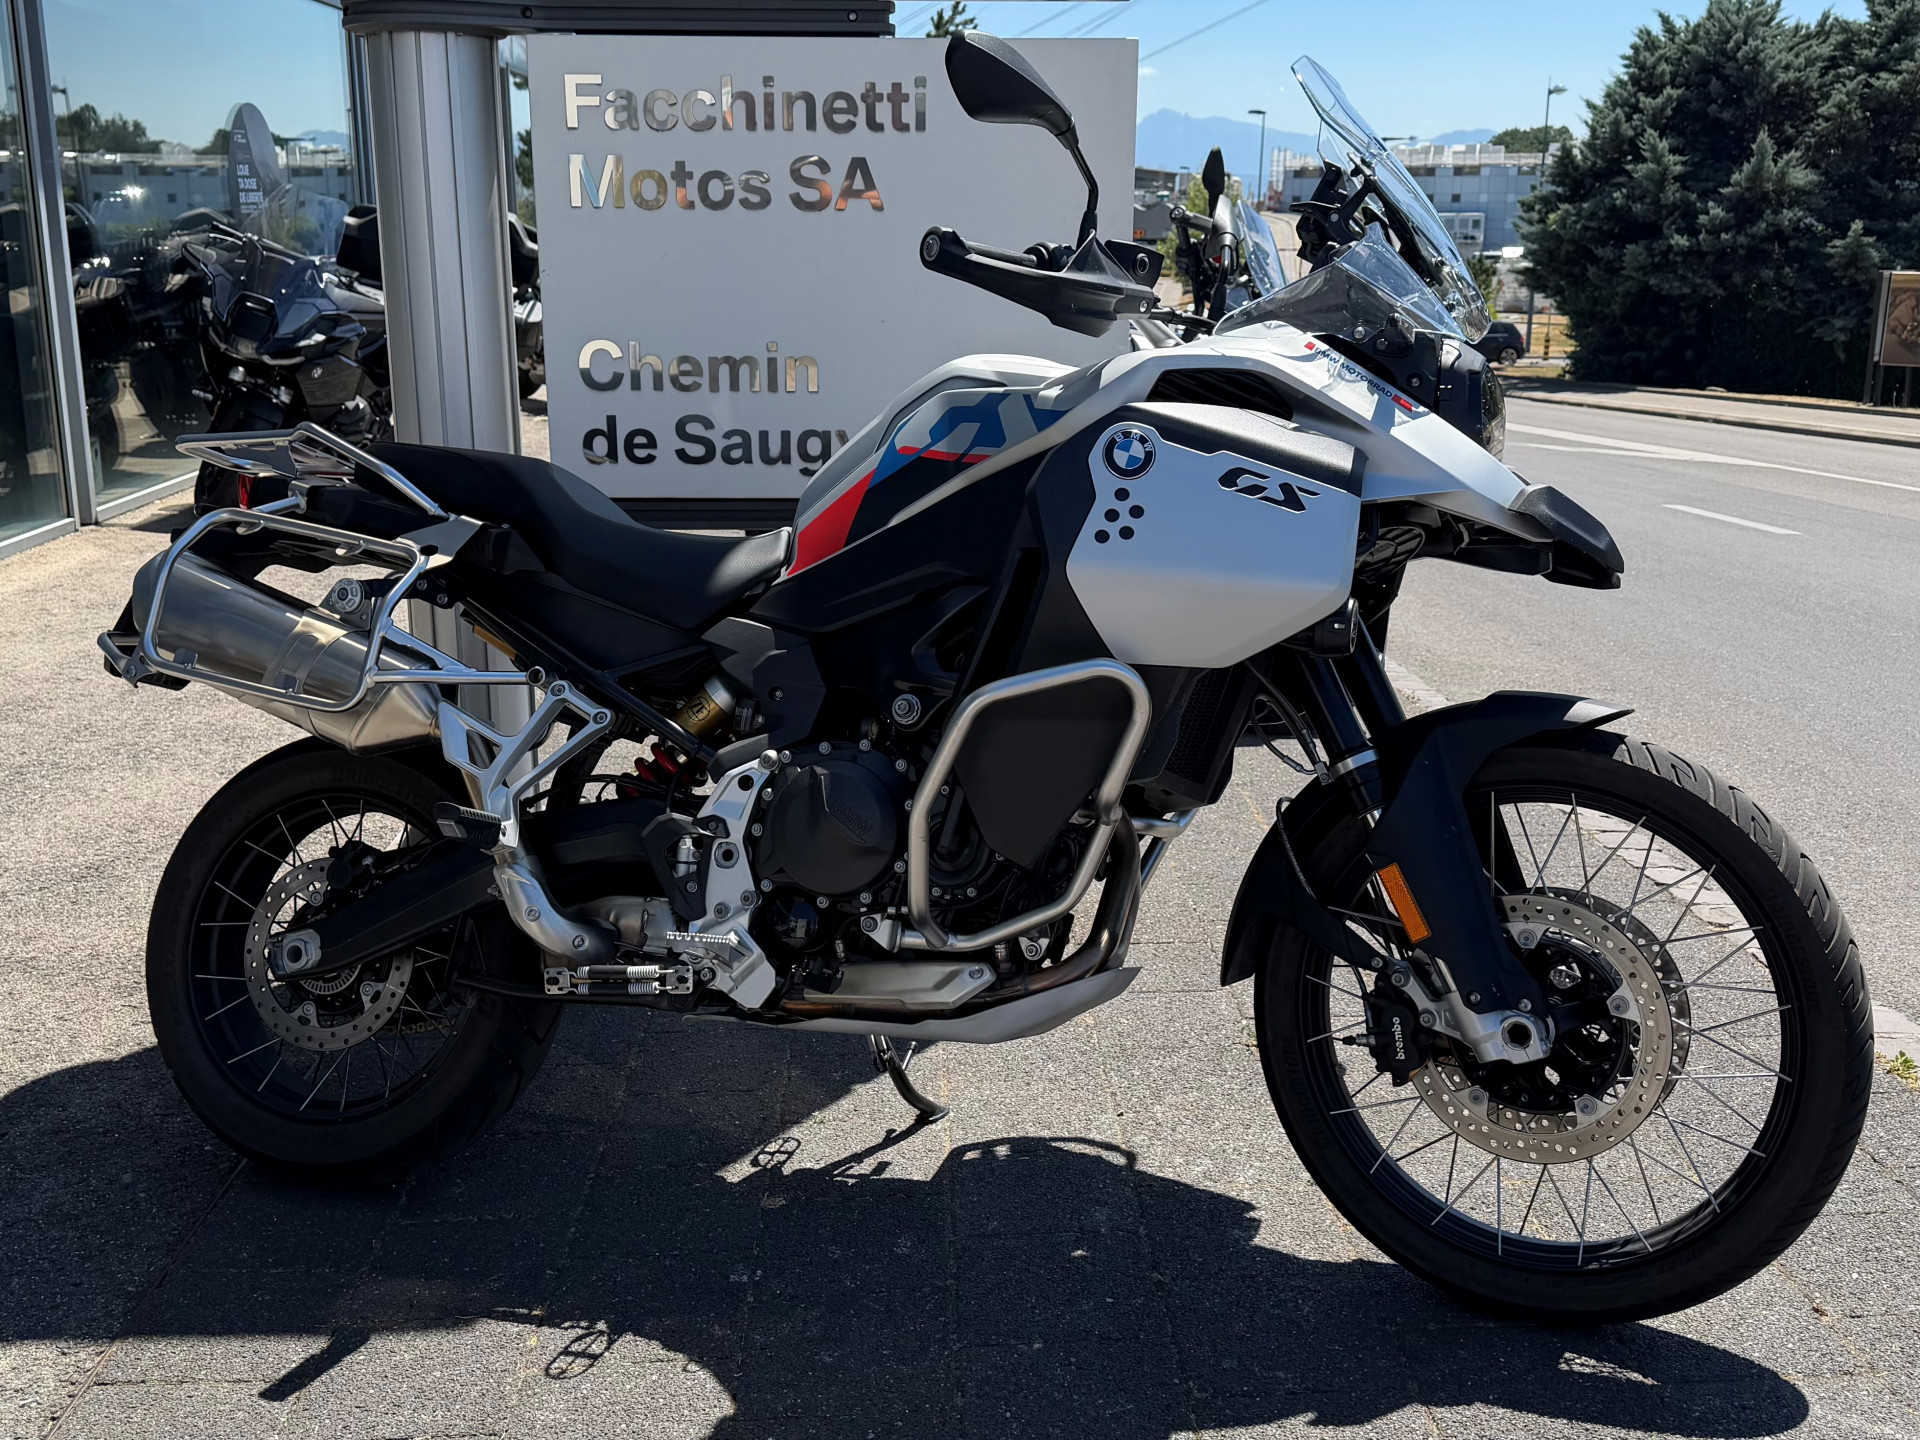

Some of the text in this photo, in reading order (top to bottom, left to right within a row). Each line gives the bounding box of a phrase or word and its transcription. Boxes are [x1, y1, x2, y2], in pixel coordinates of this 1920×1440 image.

[563, 73, 927, 133] Facchinetti
[568, 154, 885, 212] Motos SA
[578, 339, 819, 393] Chemin
[1315, 347, 1393, 398] BMW MOTORRAD
[582, 414, 658, 465] de
[1114, 430, 1153, 452] BMW
[1218, 466, 1321, 513] GS
[832, 800, 873, 836] BMW
[1392, 1016, 1406, 1060] brembo
